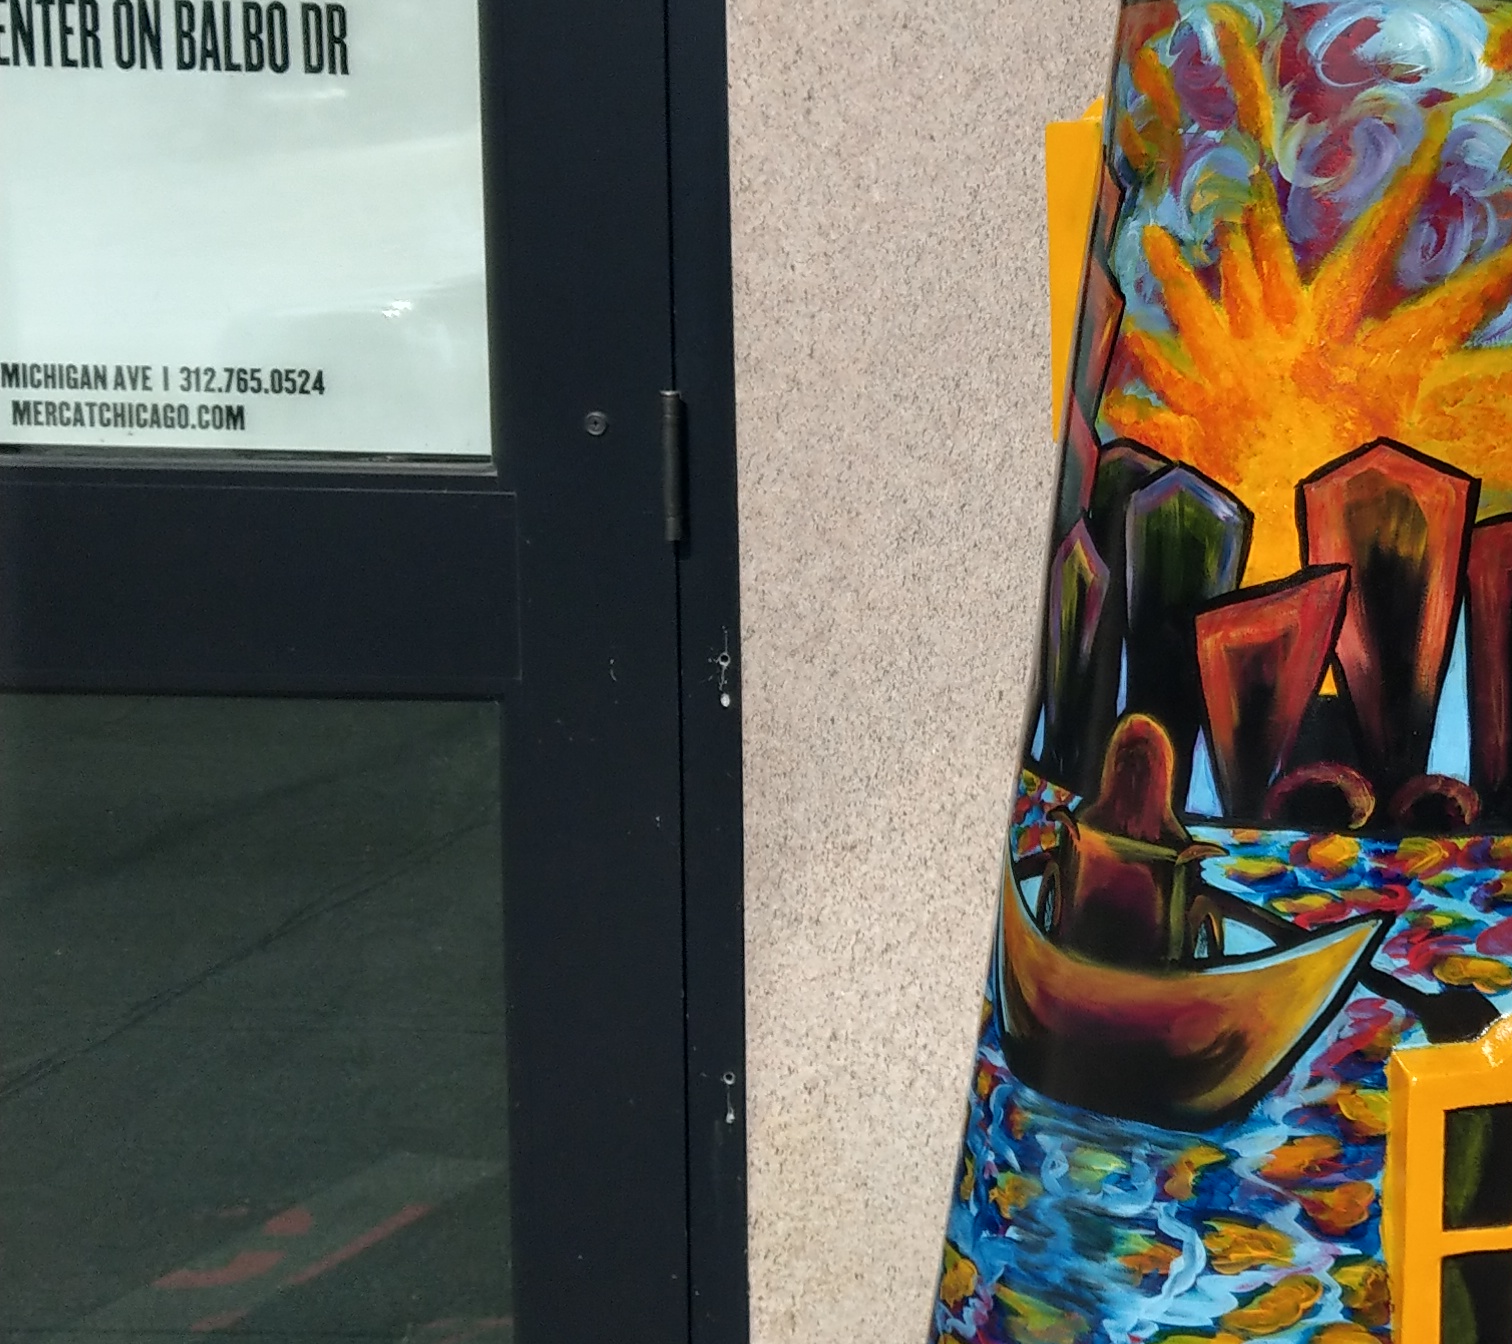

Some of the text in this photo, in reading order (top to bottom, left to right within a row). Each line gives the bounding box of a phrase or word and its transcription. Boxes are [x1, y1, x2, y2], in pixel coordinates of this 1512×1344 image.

[300, 2, 349, 76] DR
[0, 362, 107, 390] MICHIGAN
[113, 365, 152, 391] AVE
[179, 366, 325, 395] 312.765.0524
[12, 400, 245, 430] MERCATCHICAGO.COM
